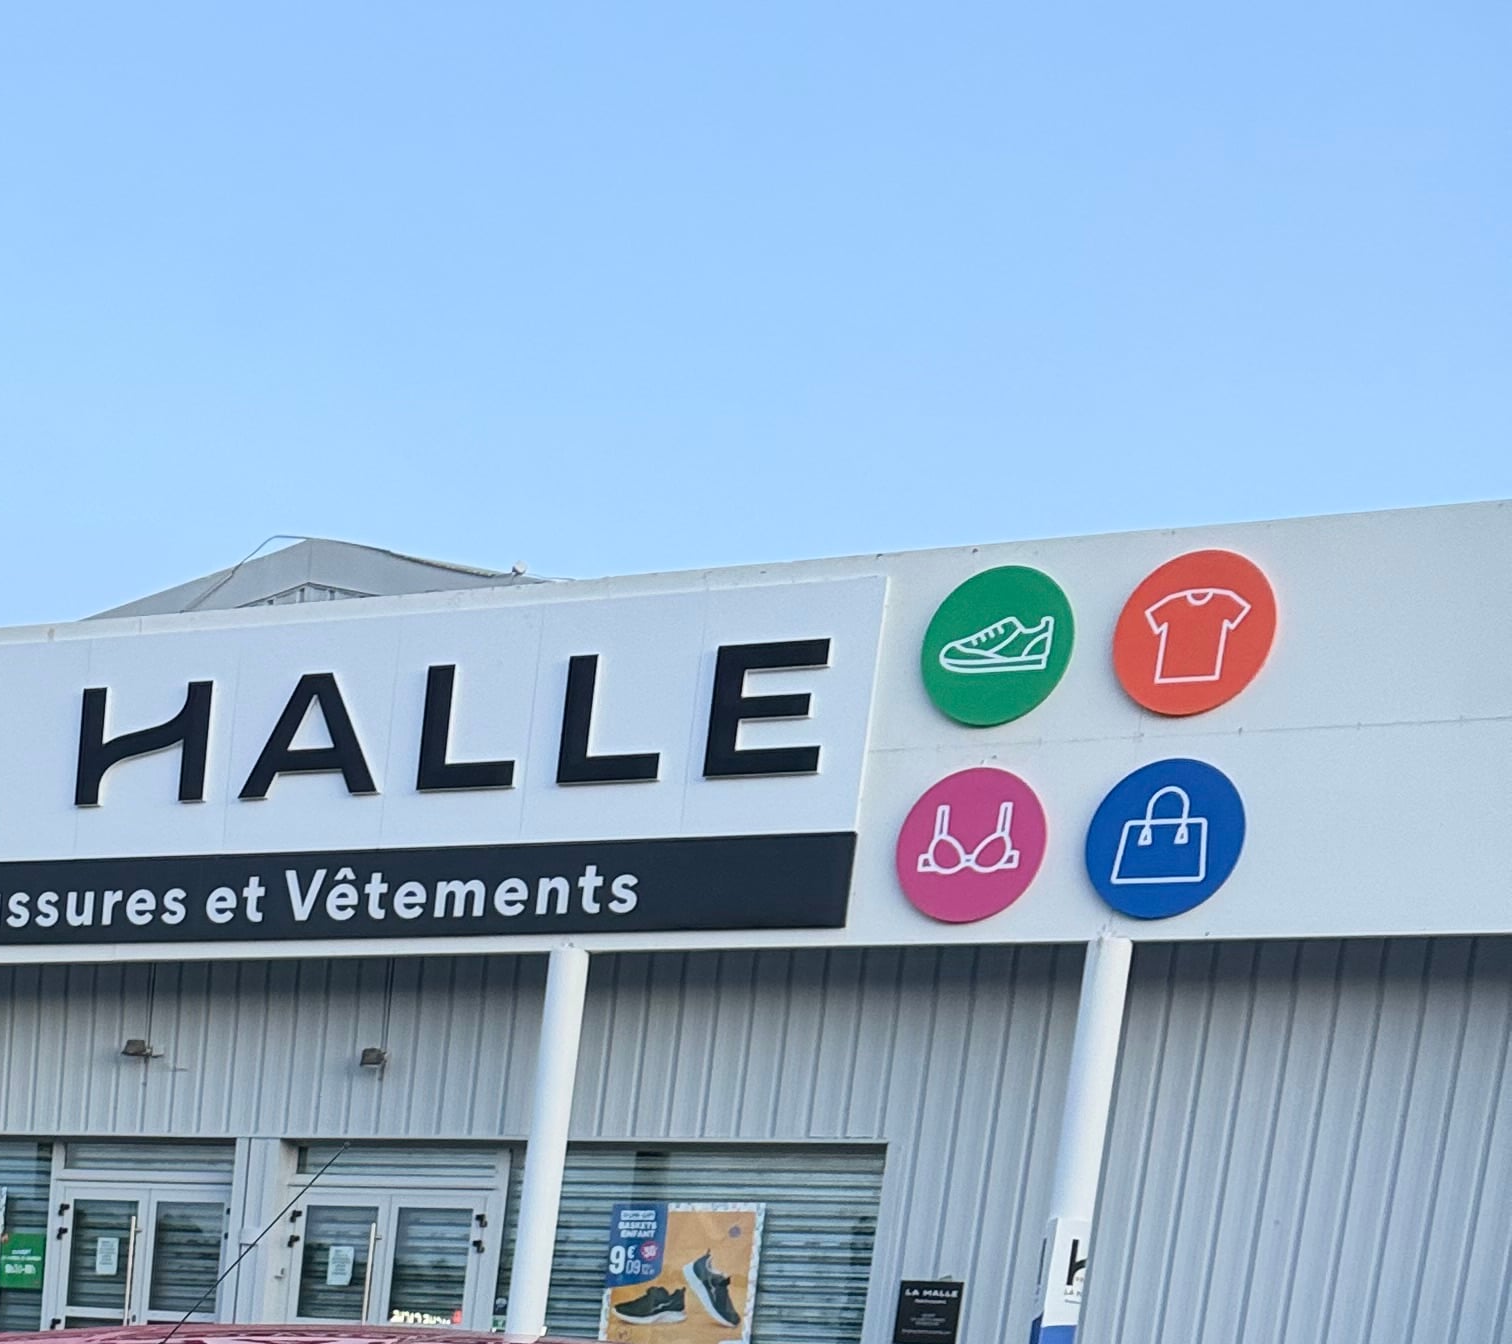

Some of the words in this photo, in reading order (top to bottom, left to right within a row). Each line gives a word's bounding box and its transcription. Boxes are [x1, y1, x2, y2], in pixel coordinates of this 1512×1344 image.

[73, 637, 833, 807] HALLE
[205, 876, 266, 924] et
[285, 864, 639, 922] Vêtements
